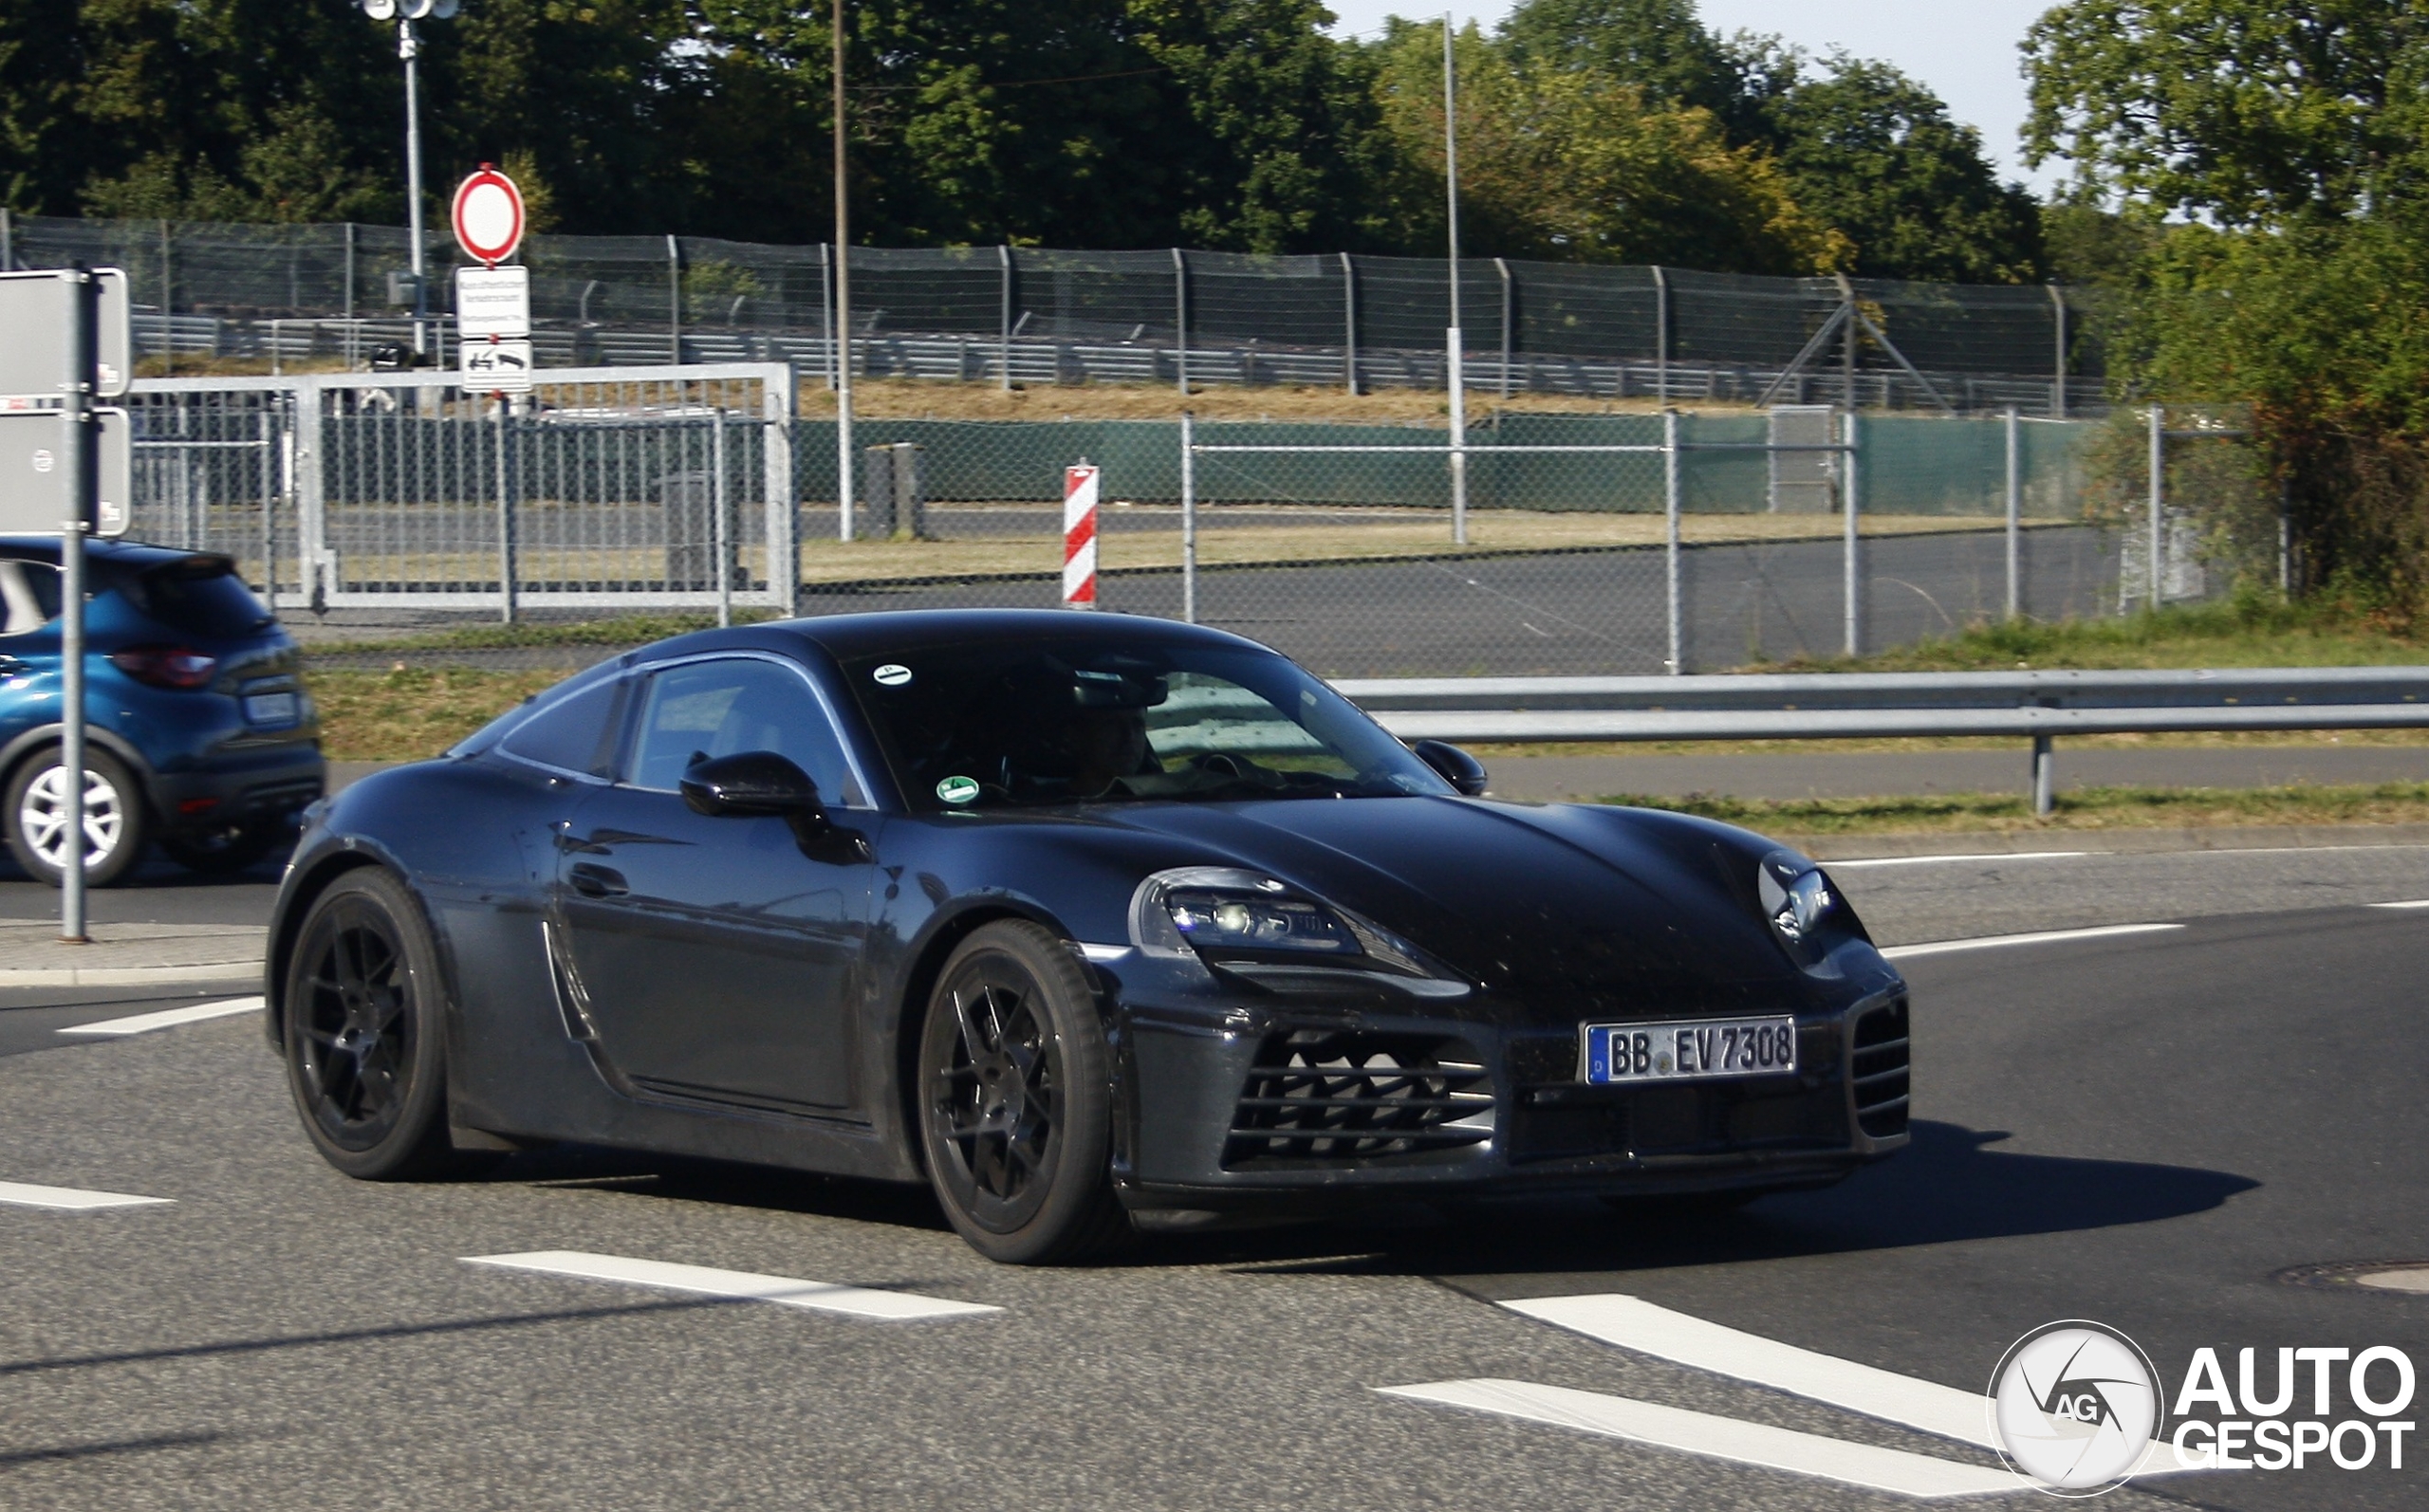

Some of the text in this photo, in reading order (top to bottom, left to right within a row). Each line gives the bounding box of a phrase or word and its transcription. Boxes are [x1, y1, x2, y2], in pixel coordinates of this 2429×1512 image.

[1610, 1024, 1791, 1075] BB EV 7308
[1594, 1060, 1604, 1073] D
